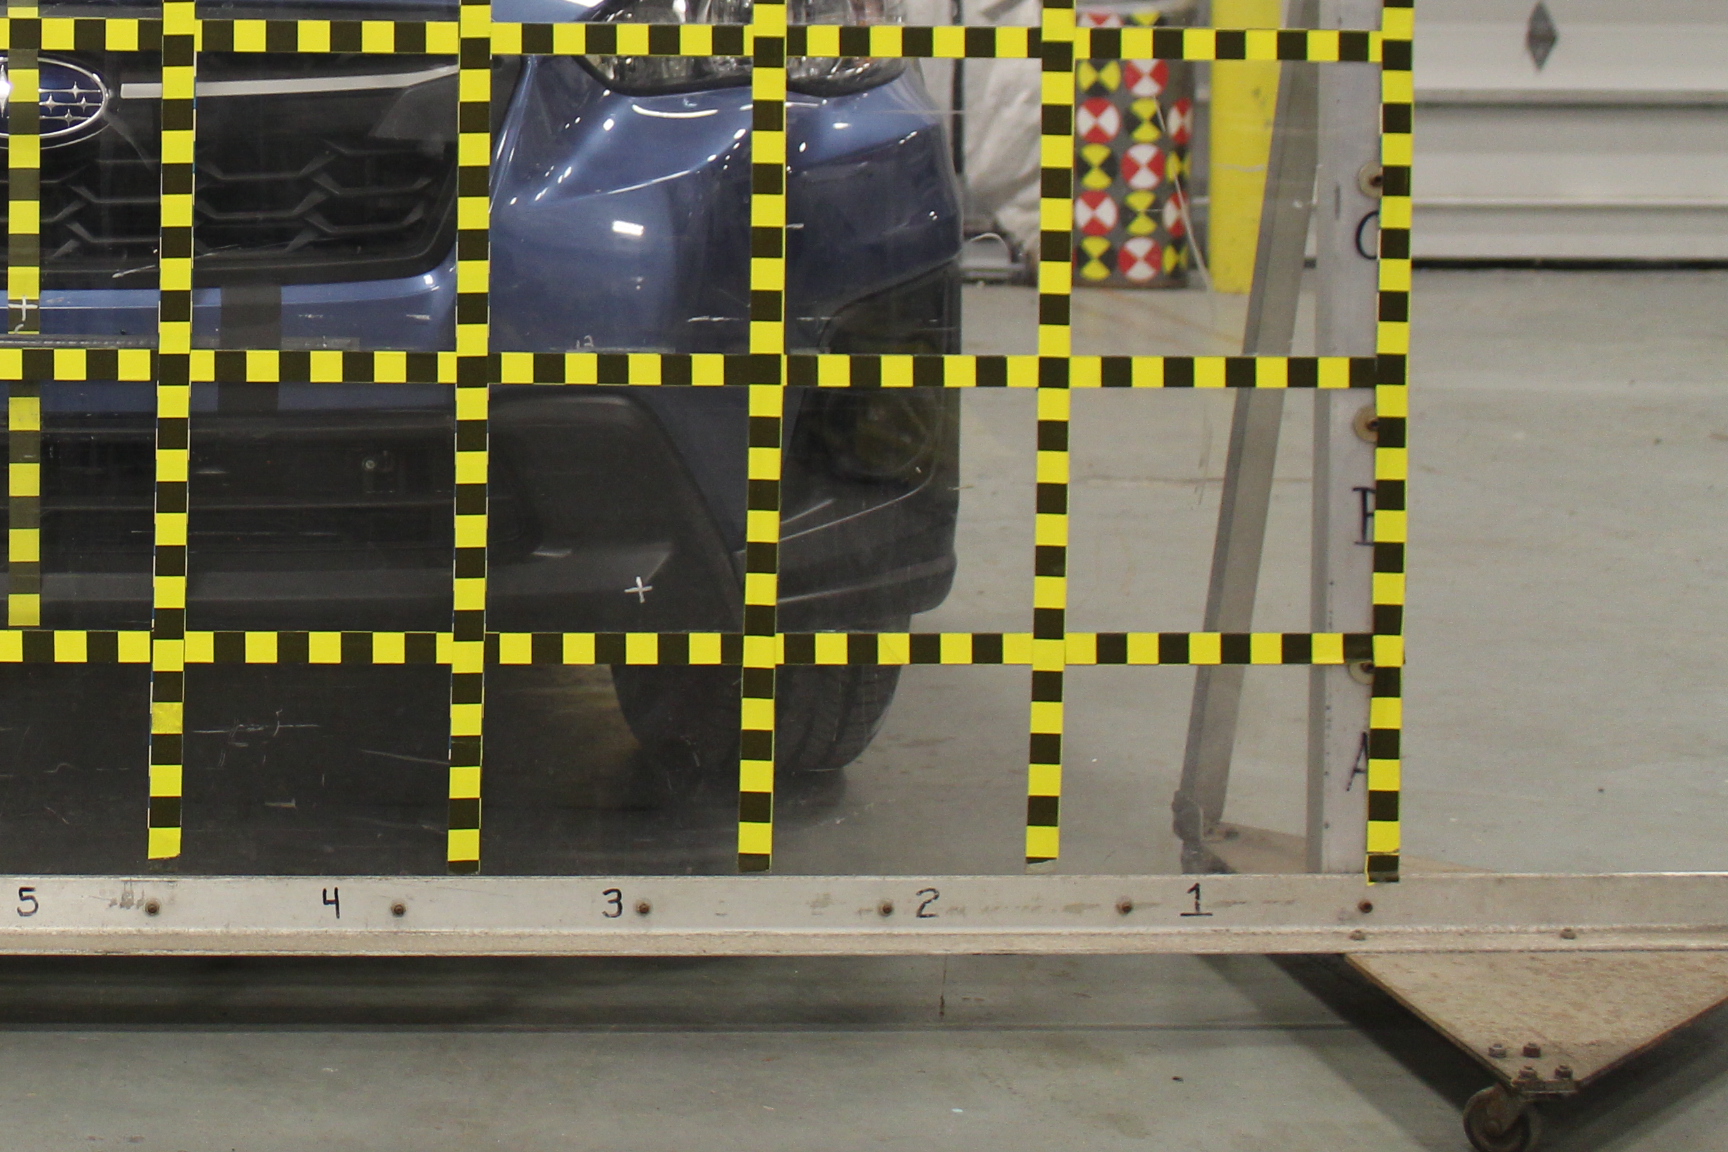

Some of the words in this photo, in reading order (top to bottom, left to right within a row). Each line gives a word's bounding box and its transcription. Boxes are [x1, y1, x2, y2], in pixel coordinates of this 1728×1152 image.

[16, 886, 39, 918] 5
[322, 886, 341, 920] 4
[602, 888, 623, 919] 3
[916, 887, 940, 919] 2
[1179, 882, 1213, 917] 1
